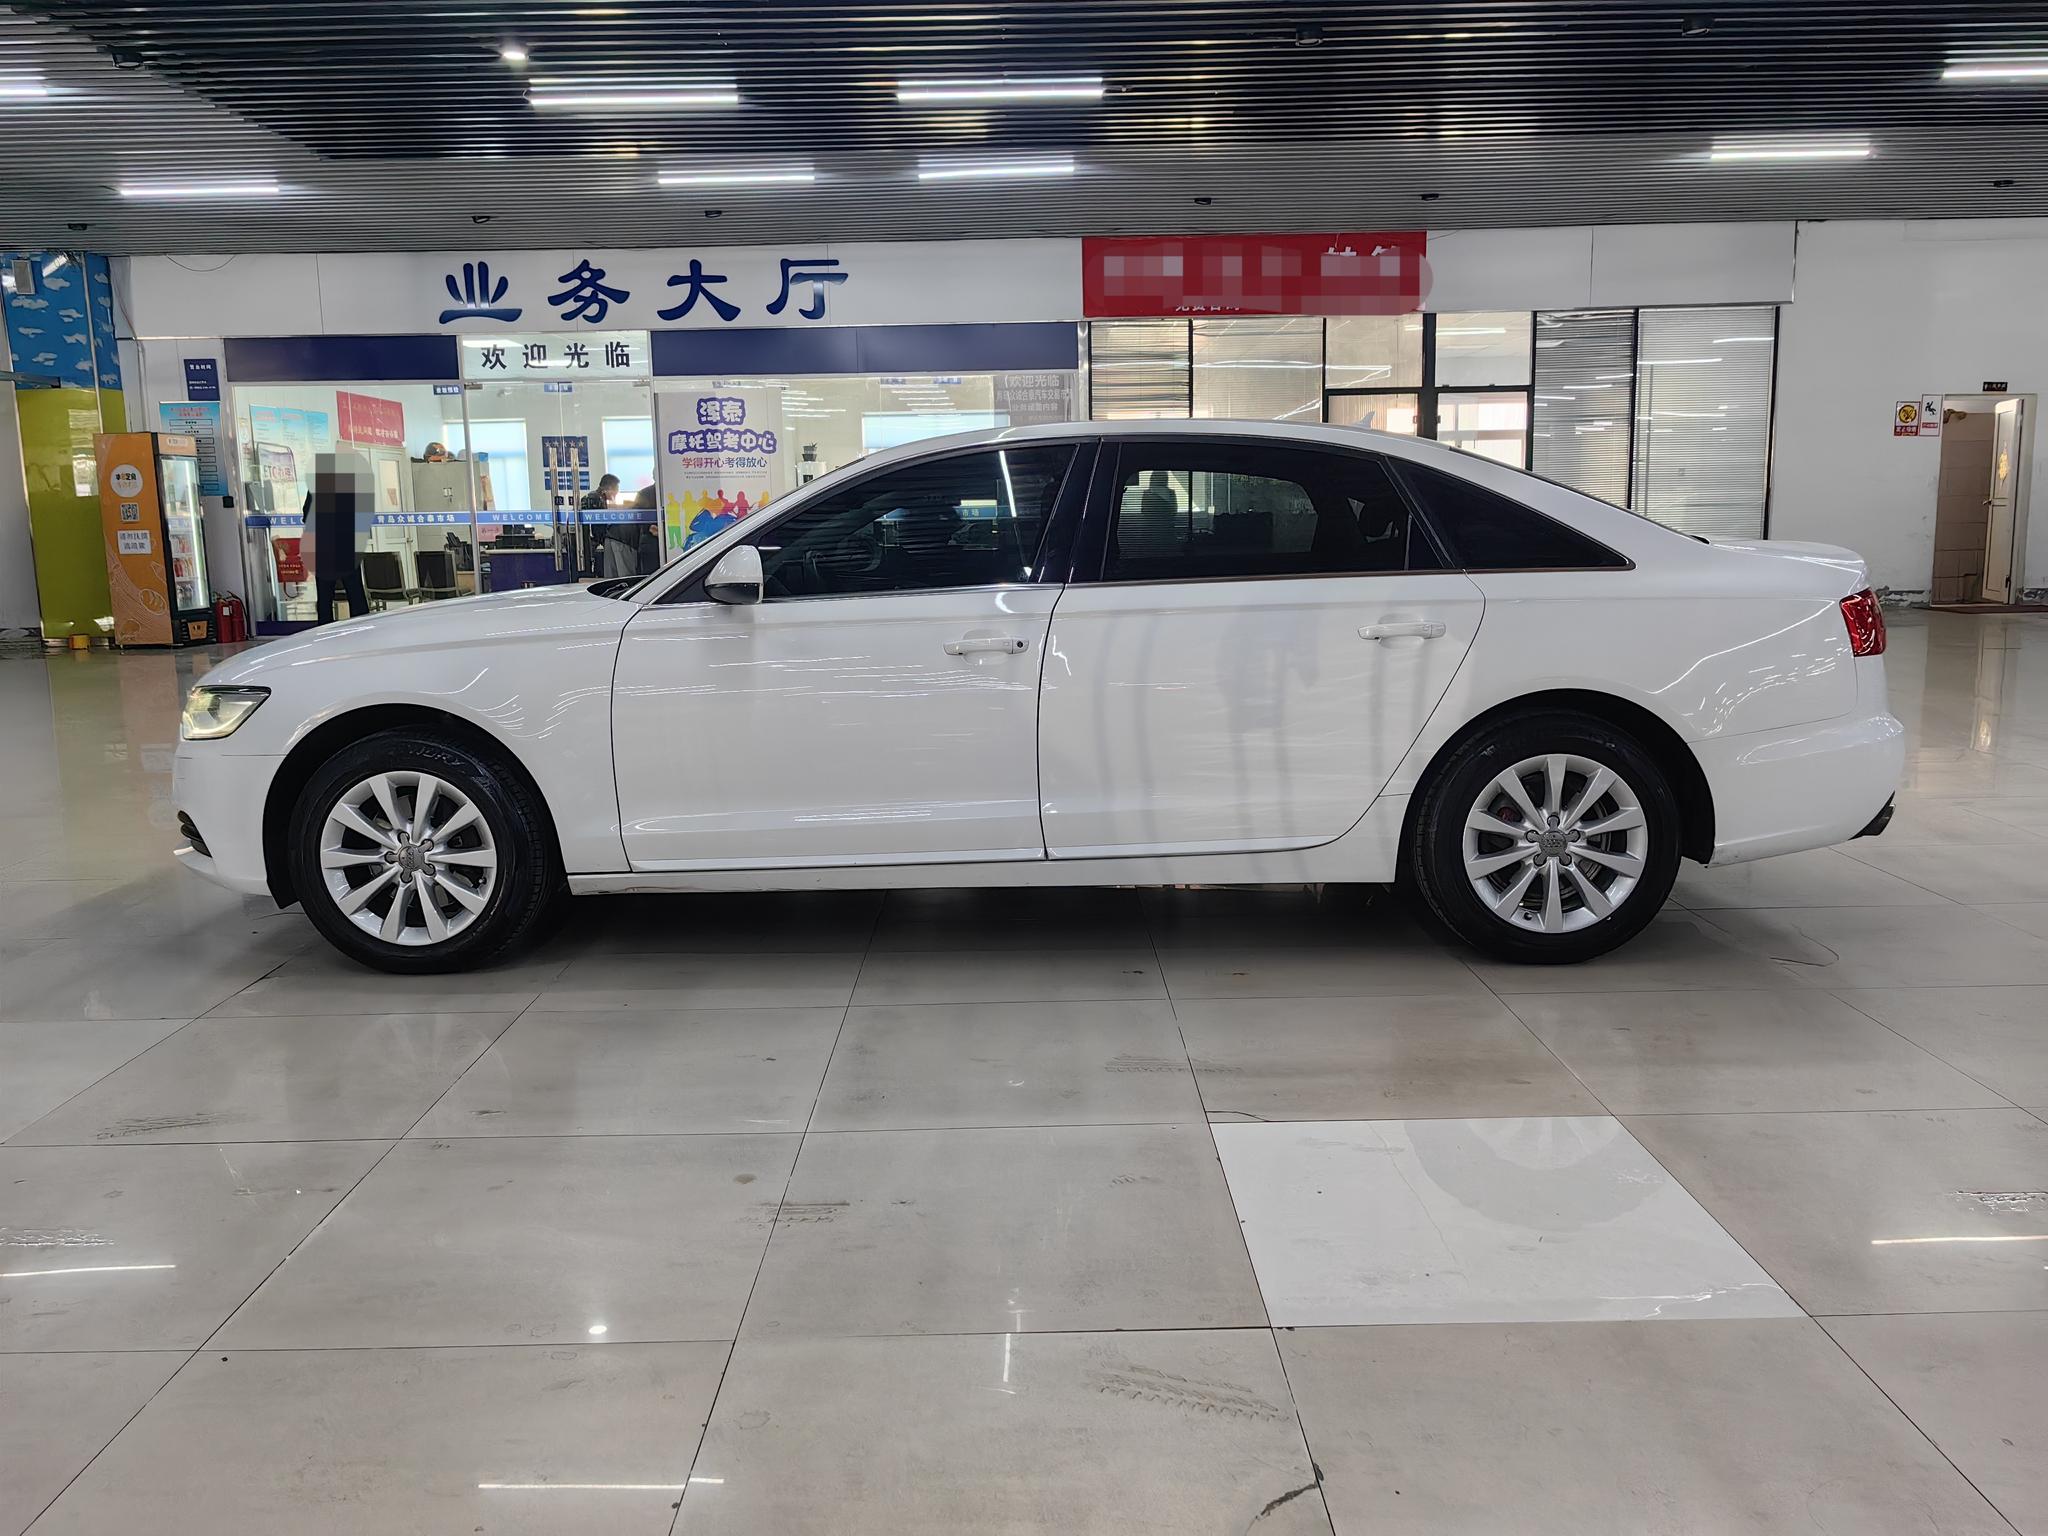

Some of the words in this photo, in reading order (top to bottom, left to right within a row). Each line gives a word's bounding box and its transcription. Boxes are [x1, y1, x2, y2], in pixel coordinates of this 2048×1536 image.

[439, 258, 849, 325] 业务大厅
[481, 341, 631, 371] 欢迎光临
[1008, 374, 1060, 388] 欢迎光临
[670, 430, 775, 452] 摩托驾考中心
[682, 457, 768, 469] 学得开心考得放心
[492, 513, 551, 521] WELCOME
[585, 512, 643, 521] WELCOME
